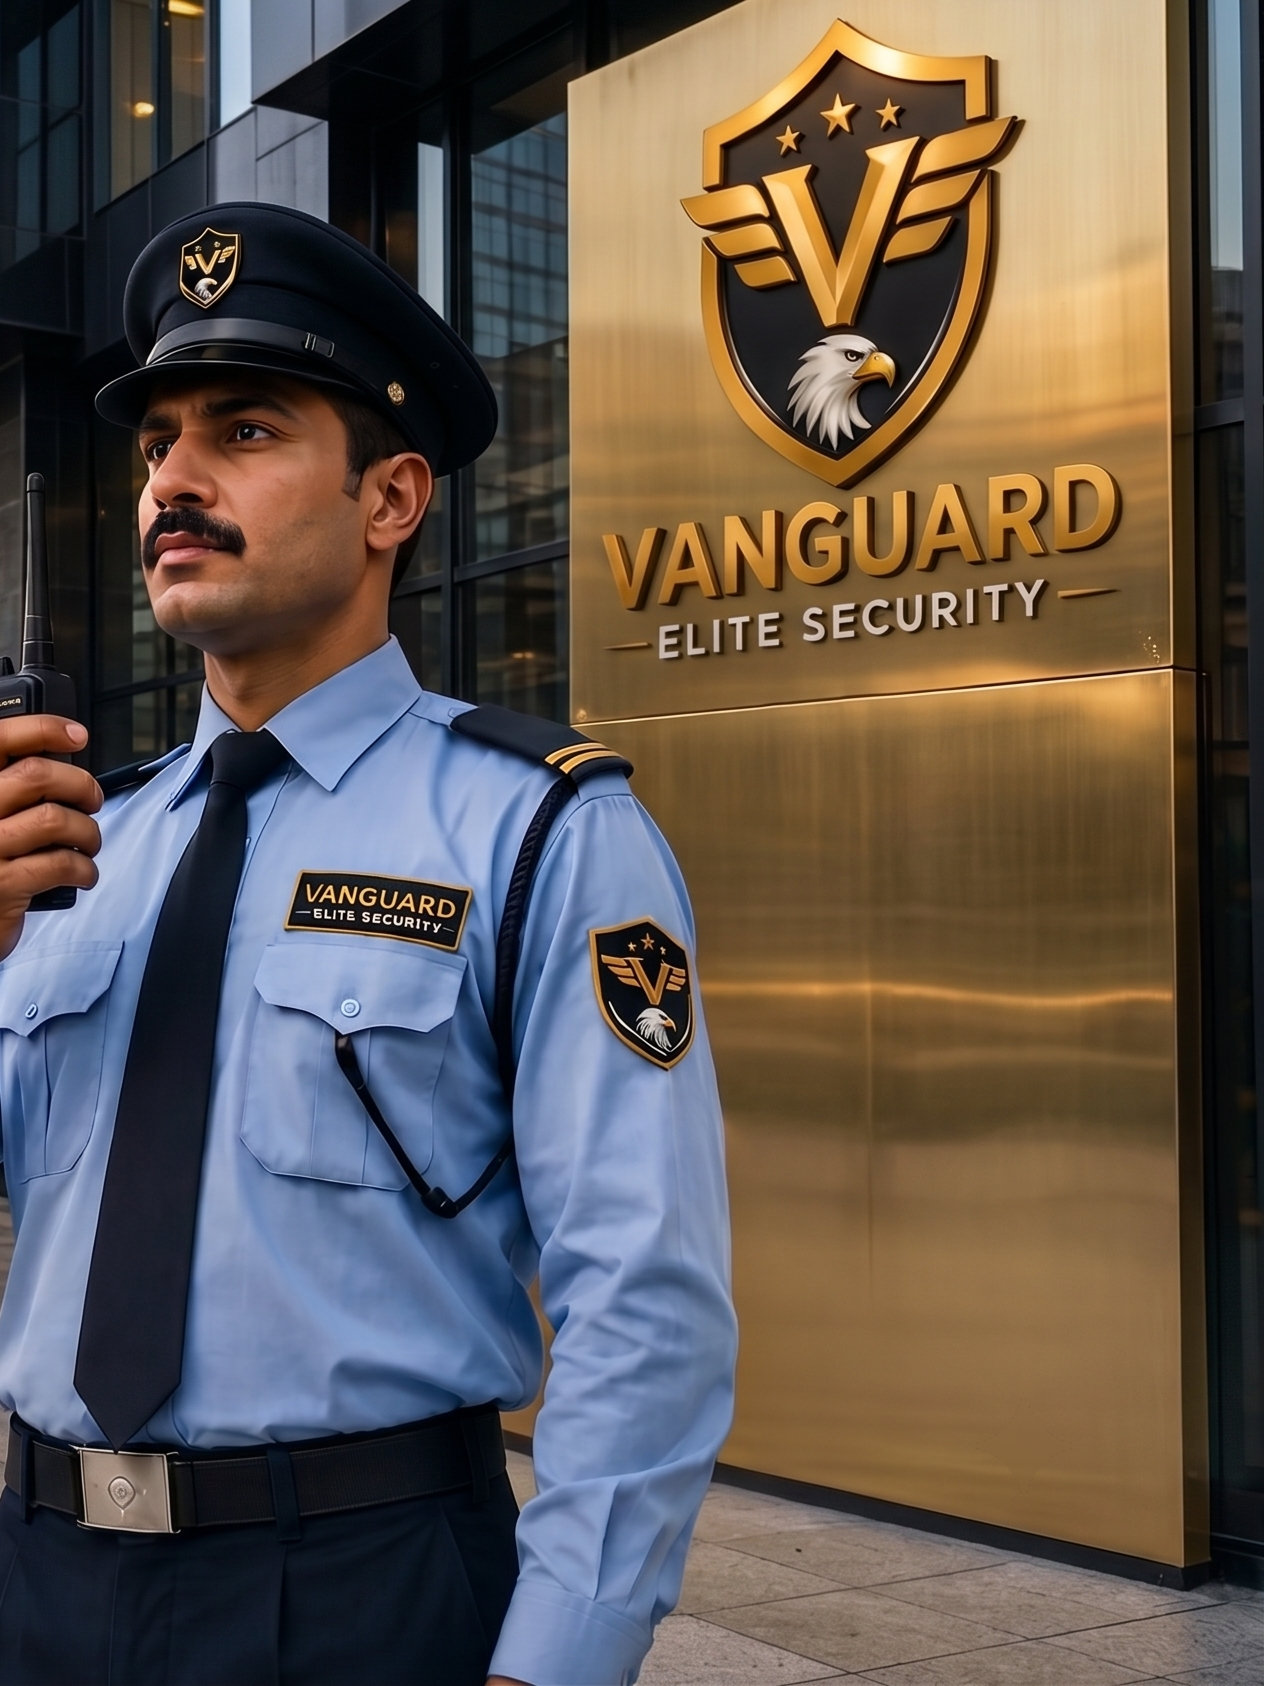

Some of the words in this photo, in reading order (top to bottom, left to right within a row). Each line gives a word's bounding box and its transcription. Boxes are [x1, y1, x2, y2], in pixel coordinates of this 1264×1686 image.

[763, 136, 925, 327] V
[602, 464, 1121, 610] VANGUARD
[658, 611, 782, 660] ELITE
[802, 579, 1047, 645] SECURITY
[306, 884, 456, 919] VANGUARD
[313, 909, 356, 922] ELITE
[361, 912, 442, 933] SECURITY
[627, 958, 671, 1006] V
